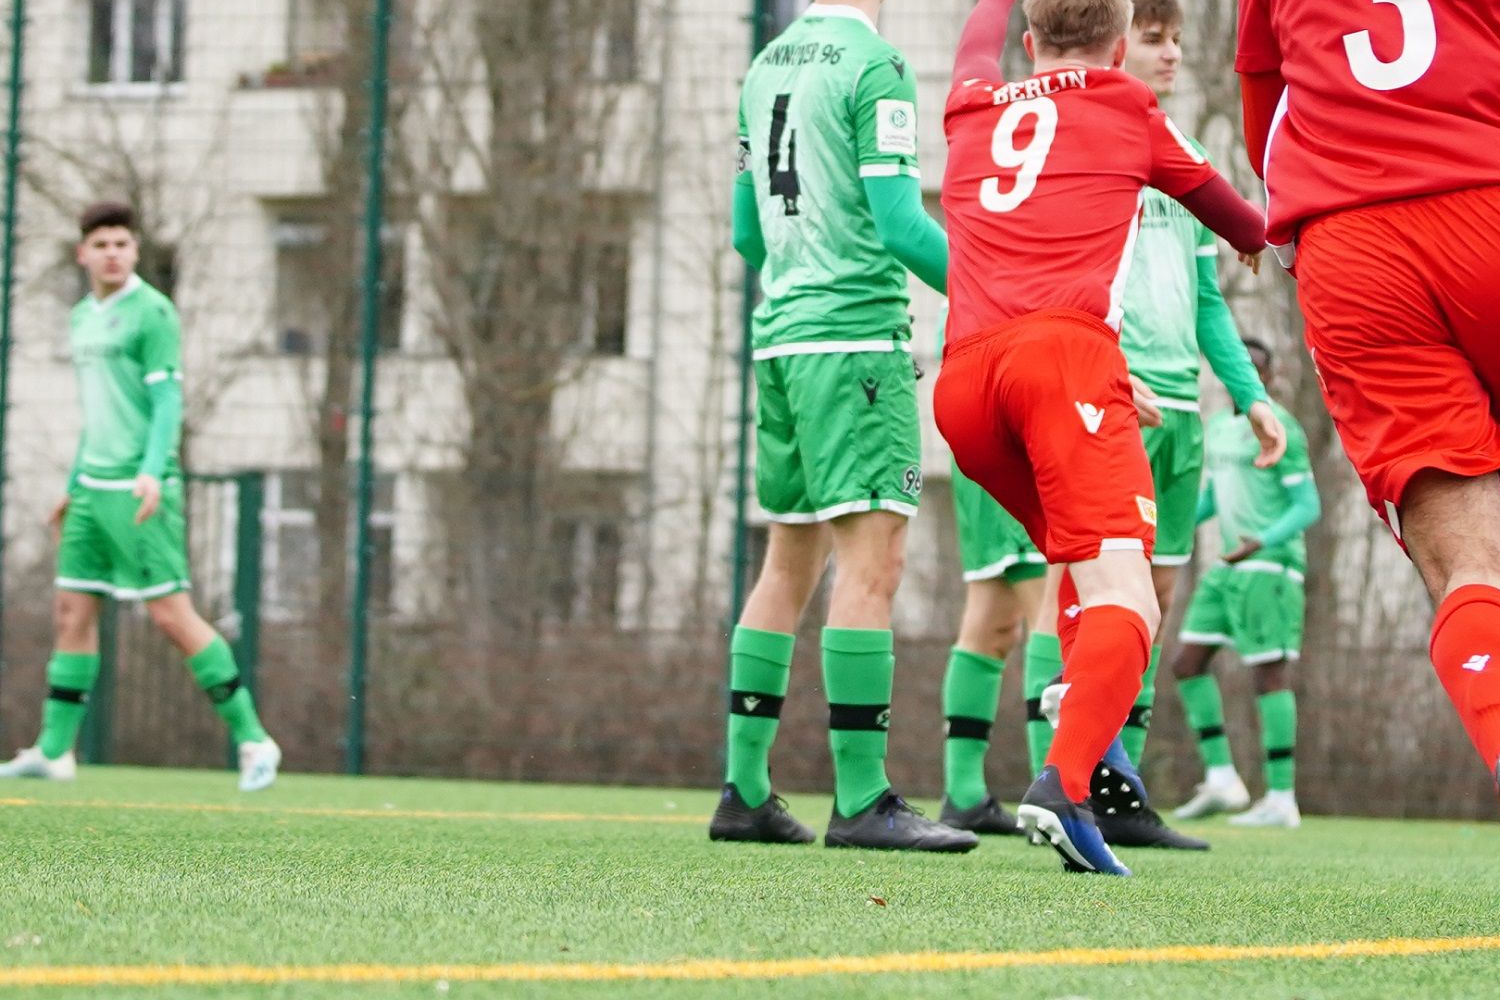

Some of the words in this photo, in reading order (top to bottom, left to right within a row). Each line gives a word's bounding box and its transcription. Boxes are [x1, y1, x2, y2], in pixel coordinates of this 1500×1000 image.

[820, 43, 847, 65] 96
[992, 69, 1088, 106] BERLIN
[767, 92, 801, 216] 4
[978, 96, 1059, 213] 9
